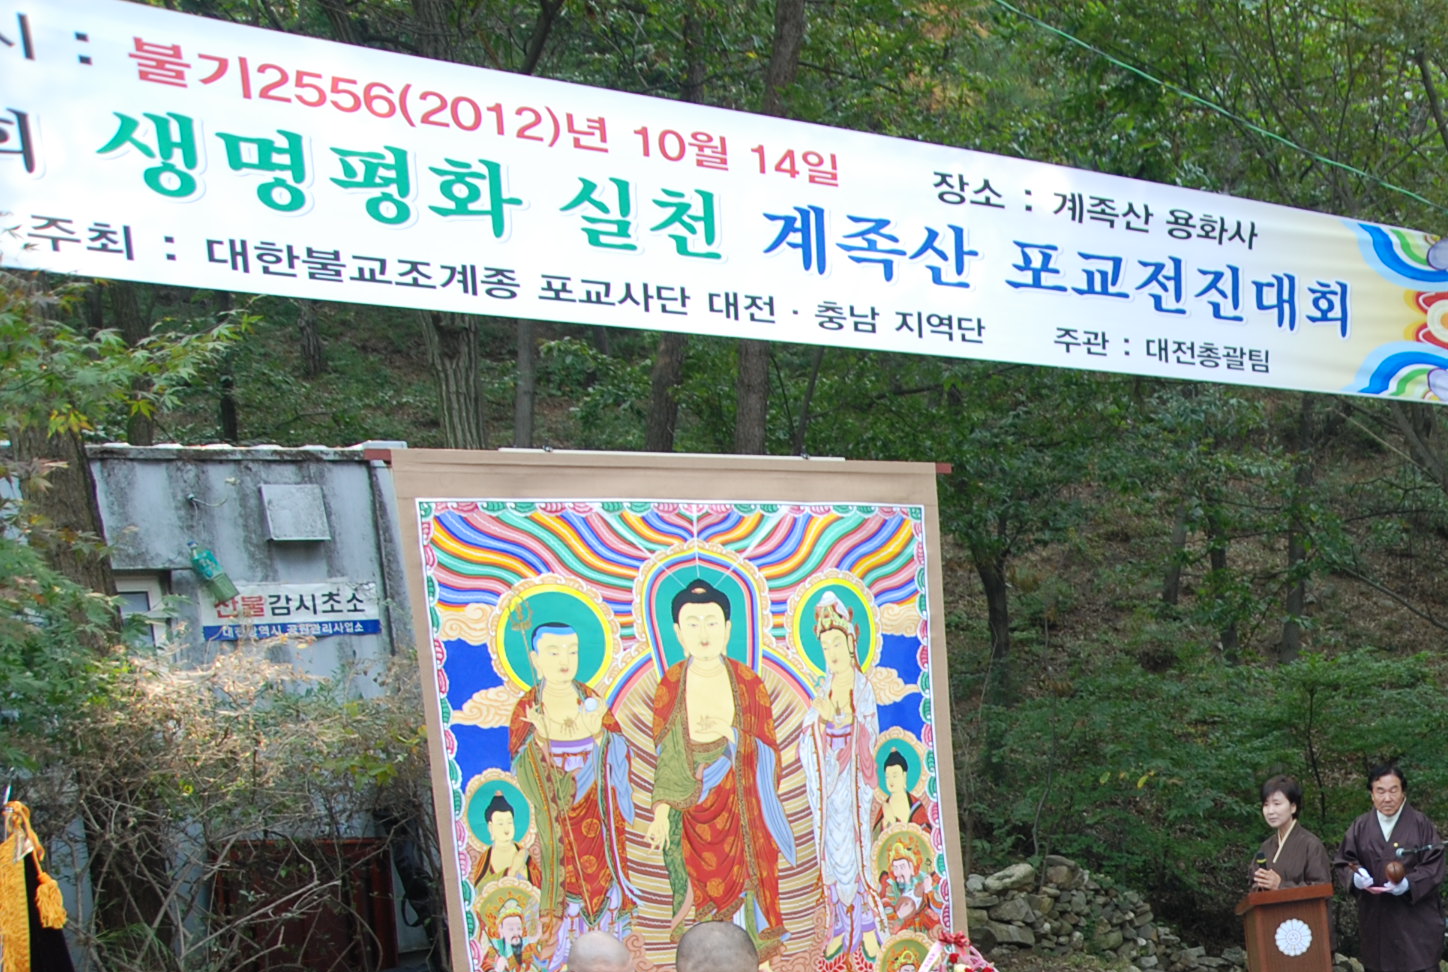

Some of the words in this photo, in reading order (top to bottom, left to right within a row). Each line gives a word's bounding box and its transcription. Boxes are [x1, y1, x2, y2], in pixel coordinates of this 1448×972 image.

[129, 37, 609, 153] 불기2556(2012)년
[635, 127, 728, 171] 10월
[752, 145, 839, 187] 14일
[96, 111, 523, 239] 생명평화
[560, 176, 723, 260] 실천
[763, 204, 979, 289] 계족산
[1005, 240, 1349, 338] 포교전진대회
[933, 171, 1006, 209] 장소
[1053, 193, 1154, 234] 계족산
[1166, 208, 1258, 250] 용화사
[28, 215, 134, 261] 주최
[206, 239, 520, 299] 대한불교조계종
[539, 275, 691, 316] 포교사단
[709, 292, 775, 323] 대전
[816, 302, 880, 334] 충남
[896, 311, 986, 344] 지역단
[1054, 328, 1110, 357] 주관
[1145, 339, 1270, 374] 대전총괄팀
